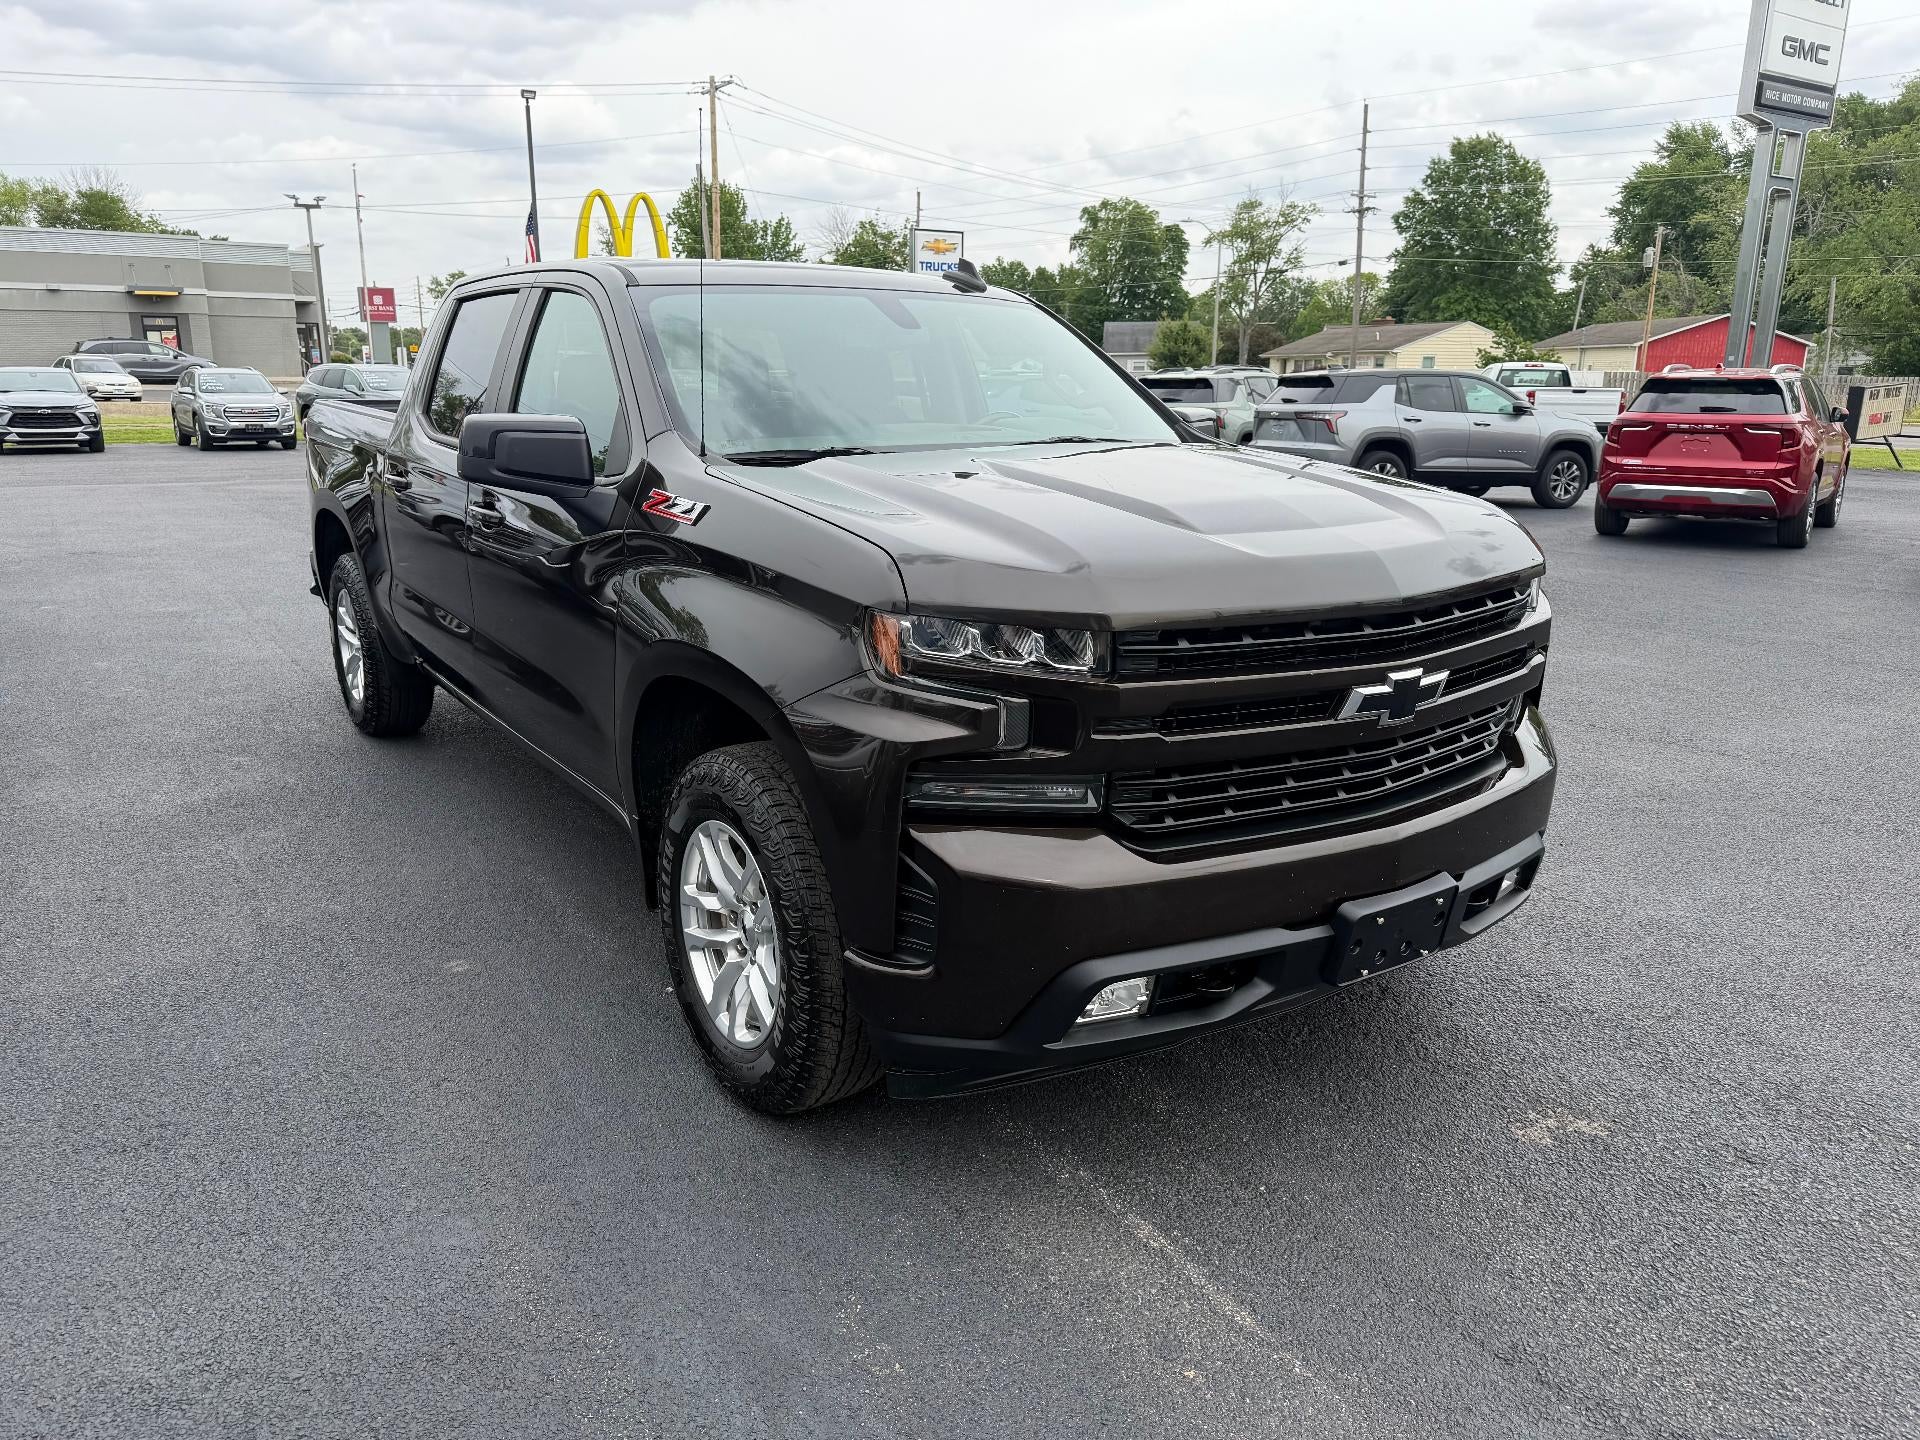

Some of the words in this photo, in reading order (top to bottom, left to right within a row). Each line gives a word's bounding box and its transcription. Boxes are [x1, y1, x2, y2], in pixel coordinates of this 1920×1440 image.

[1782, 35, 1831, 65] GMC
[1766, 90, 1780, 101] RICE
[1782, 93, 1801, 104] MOTOR
[1803, 97, 1829, 109] COMPANY
[641, 488, 712, 527] Z71
